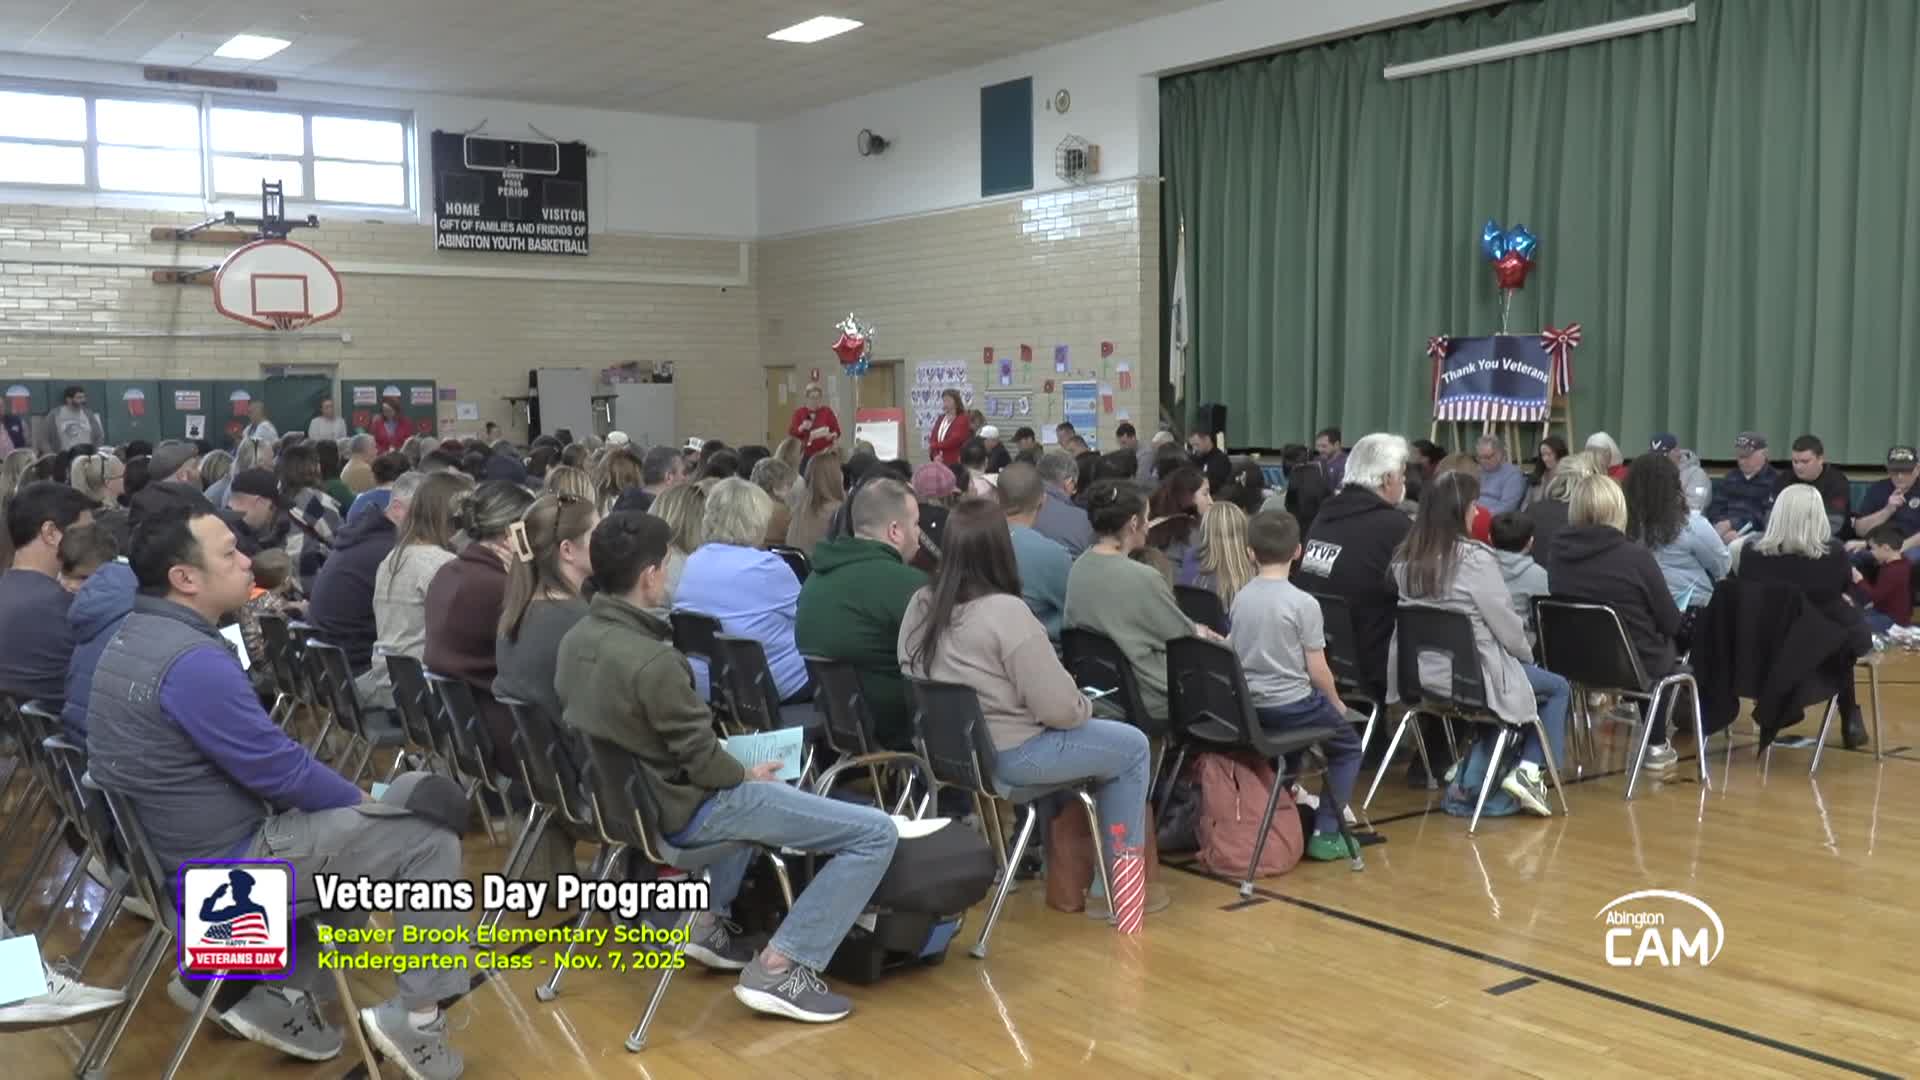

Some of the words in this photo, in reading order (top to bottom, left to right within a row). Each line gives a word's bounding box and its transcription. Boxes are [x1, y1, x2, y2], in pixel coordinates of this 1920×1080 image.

[498, 187, 529, 198] PERIOD
[445, 202, 480, 216] HOME
[541, 208, 585, 222] VISITOR
[439, 218, 459, 231] GIFT
[460, 219, 473, 231] OF
[475, 220, 514, 233] FAMILIES
[516, 222, 535, 234] AND
[536, 223, 572, 236] FRIENDS
[574, 225, 586, 237] OF
[438, 233, 490, 249] ABINGTON
[491, 236, 525, 250] YOUTH
[528, 238, 588, 254] BASKETBALL
[1441, 361, 1476, 385] Thank
[1478, 358, 1499, 371] You
[1502, 357, 1548, 384] Veterans
